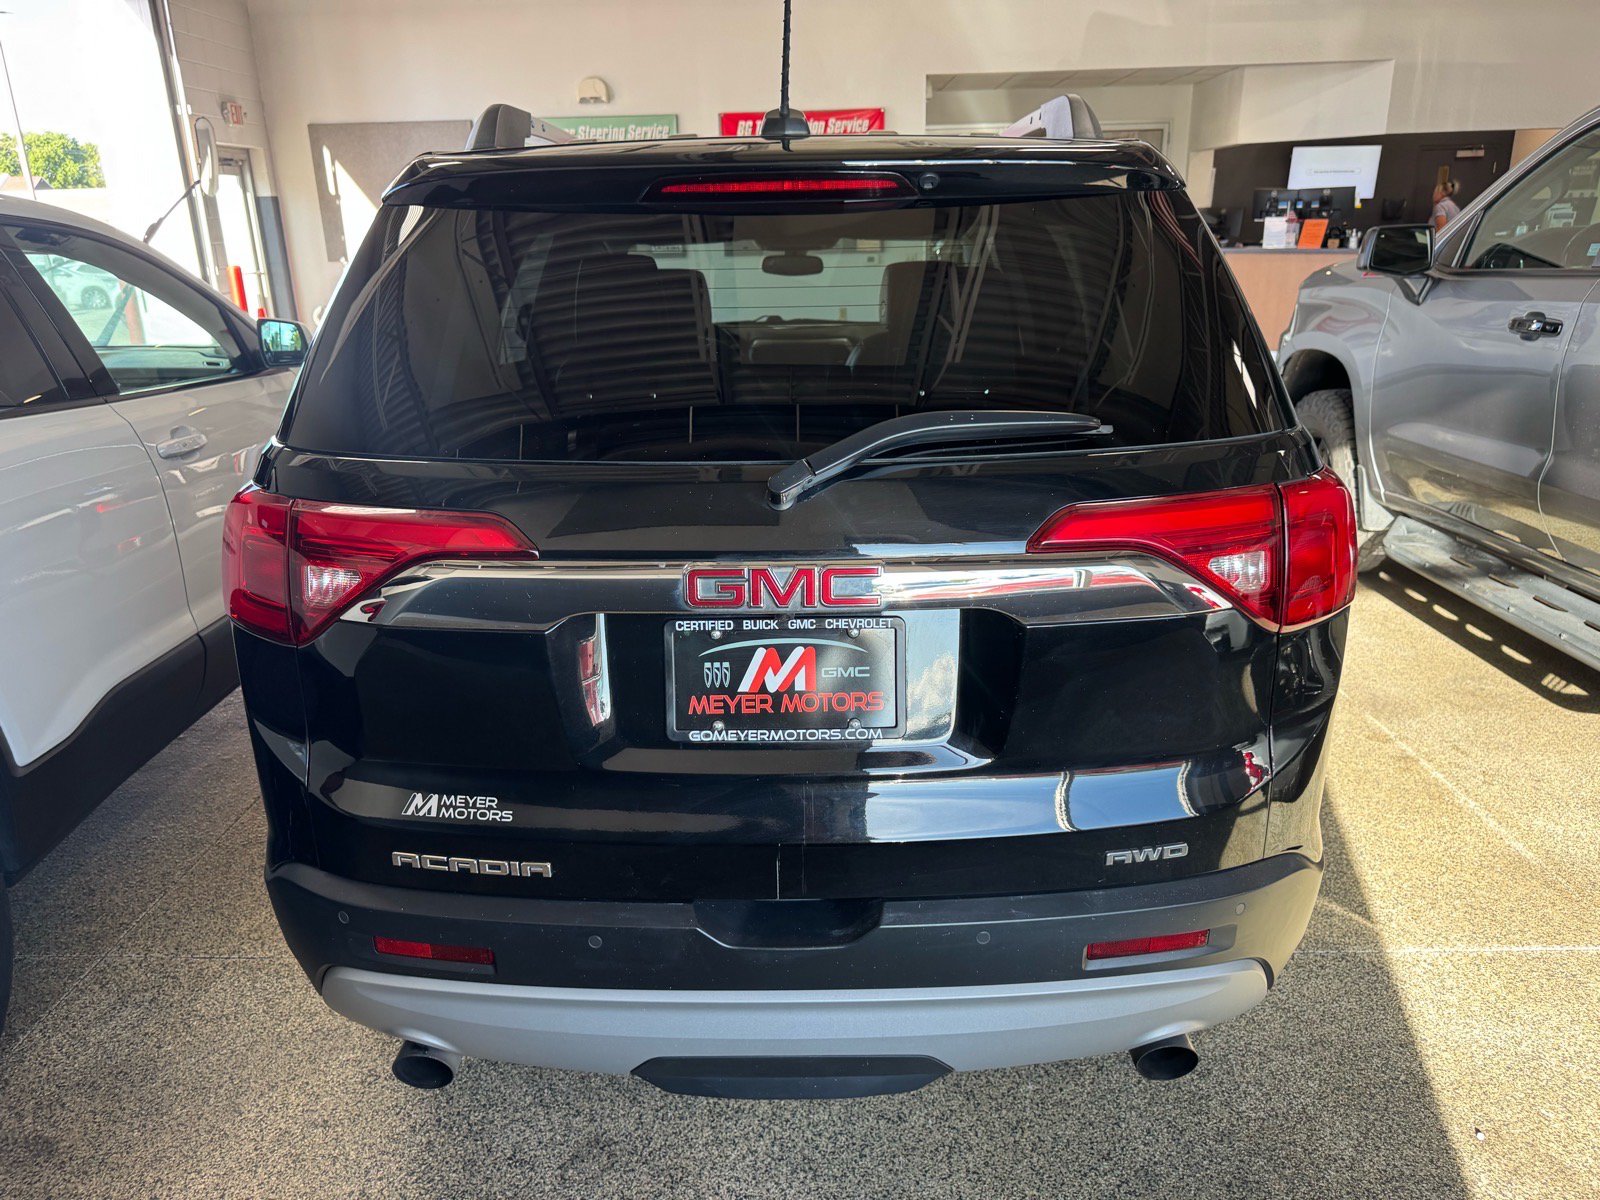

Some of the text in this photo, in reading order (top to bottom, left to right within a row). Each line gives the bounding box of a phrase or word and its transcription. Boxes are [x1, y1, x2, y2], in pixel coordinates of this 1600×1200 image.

[579, 125, 626, 141] Steering
[628, 124, 670, 140] Service
[738, 120, 753, 136] BG
[827, 117, 871, 134] Service
[684, 565, 884, 608] GMC
[675, 618, 893, 632] CERTIFIED BUICK GMC CHEVROLET
[821, 666, 870, 678] GMC
[688, 692, 884, 715] MEYER MOTORS
[688, 728, 883, 741] GOMEYERMOTORS.COM
[441, 794, 497, 808] MEYER
[439, 808, 513, 822] MOTORS
[1105, 842, 1189, 866] AWD
[391, 851, 552, 878] ACADIA
